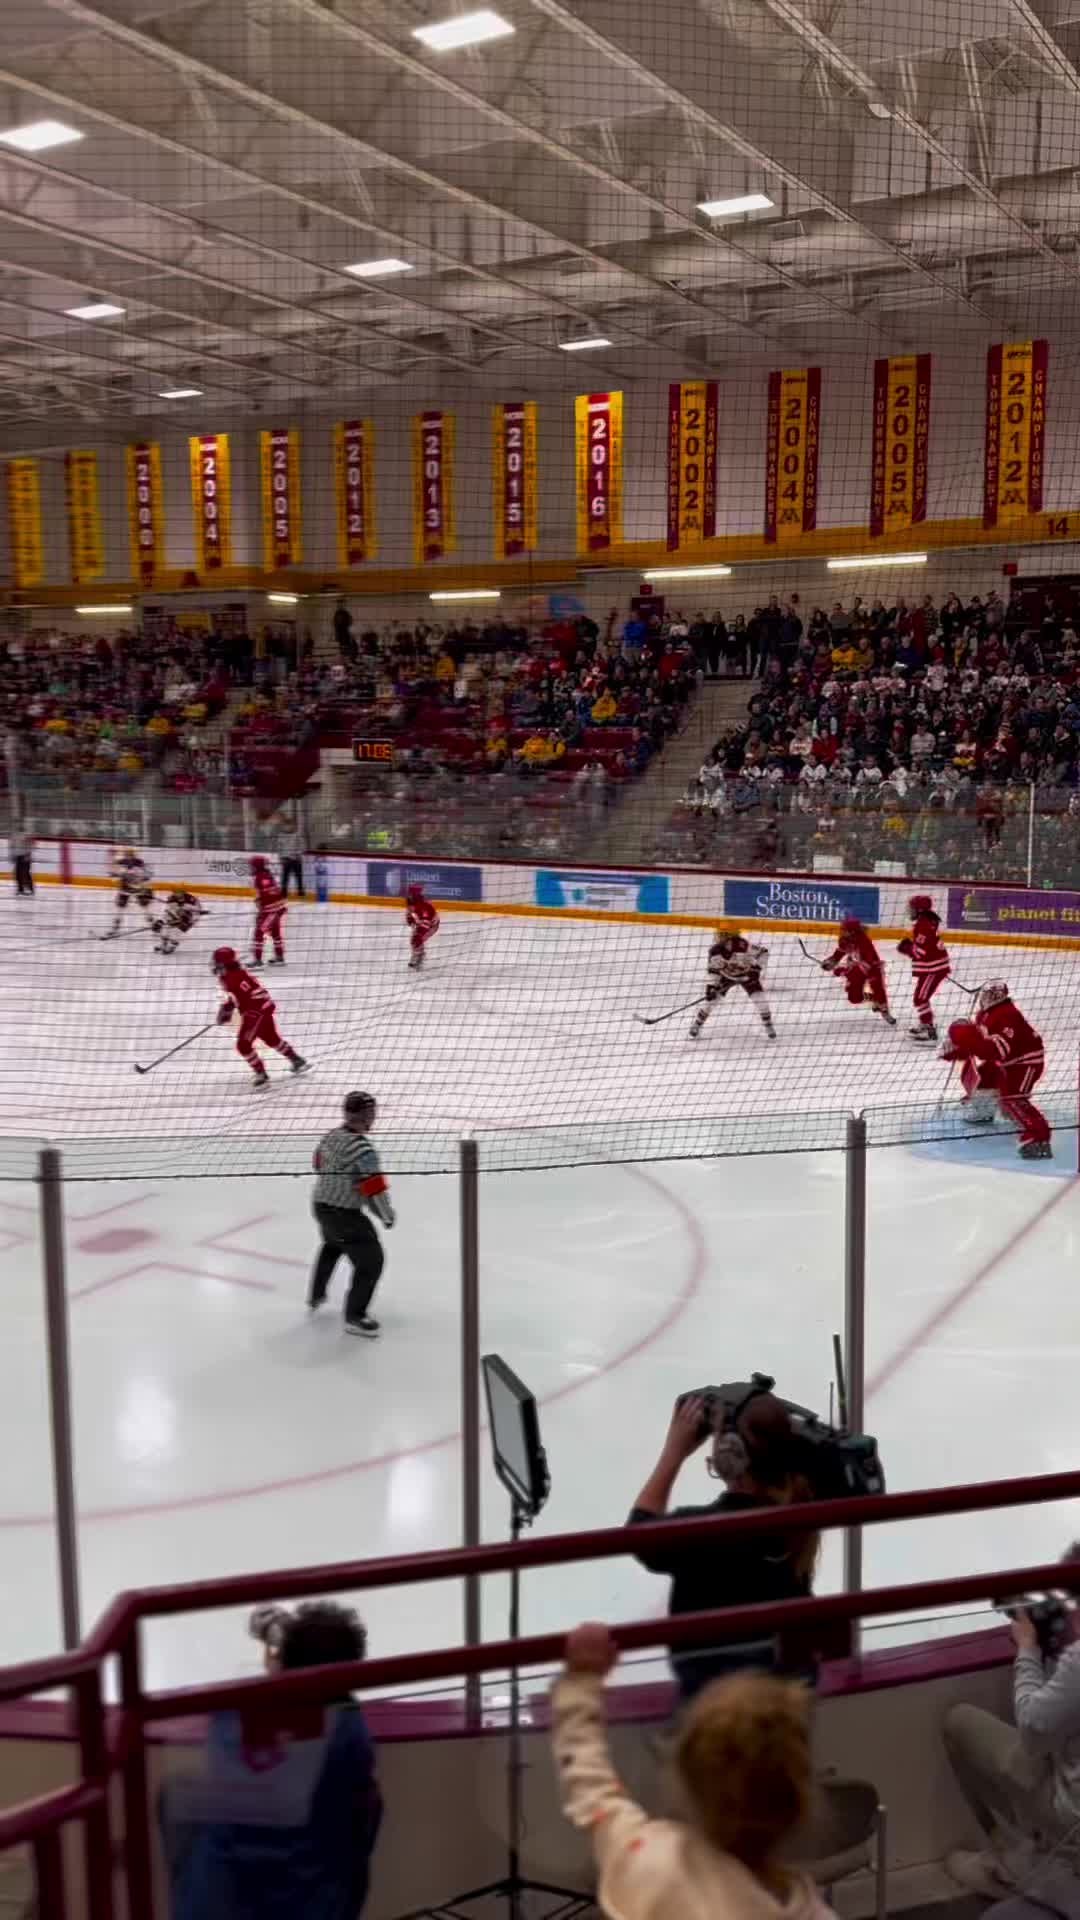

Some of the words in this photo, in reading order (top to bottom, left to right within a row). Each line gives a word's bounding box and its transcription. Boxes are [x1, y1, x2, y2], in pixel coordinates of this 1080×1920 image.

[591, 418, 607, 517] 2016
[684, 409, 700, 510] 2002
[782, 398, 801, 502] 2004
[891, 385, 910, 493] 2005
[1005, 372, 1025, 483] 2012
[1032, 369, 1044, 490] CHAMPIONS
[203, 457, 218, 541] 2004
[273, 450, 288, 538] 2005
[347, 443, 361, 533] 2012
[425, 435, 441, 528] 2013
[507, 427, 522, 523] 2015
[1048, 516, 1070, 536] 14
[769, 882, 829, 904] Boston
[997, 905, 1057, 921] planet
